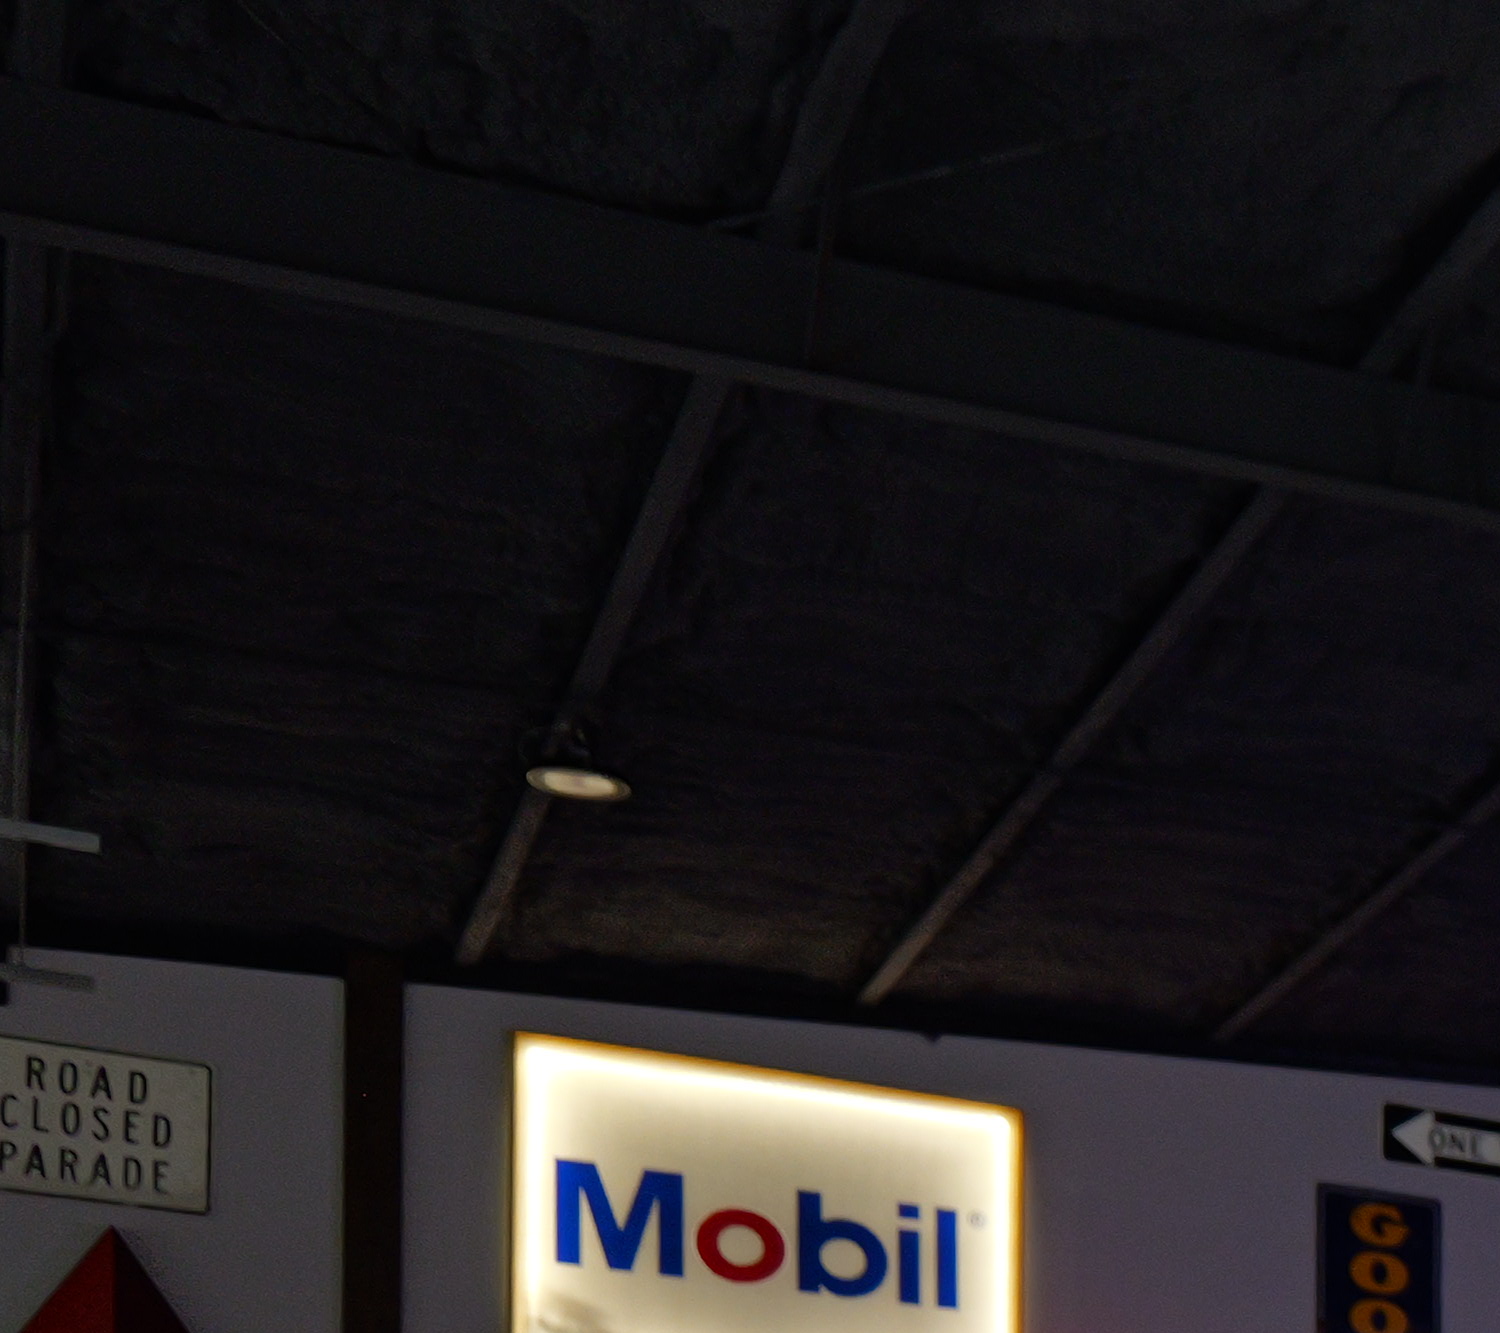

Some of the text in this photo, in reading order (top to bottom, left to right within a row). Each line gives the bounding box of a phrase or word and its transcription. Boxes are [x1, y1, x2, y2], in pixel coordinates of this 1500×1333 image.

[25, 1055, 149, 1105] ROAD
[0, 1093, 172, 1148] CLOSED
[1428, 1123, 1480, 1160] ONE
[0, 1141, 171, 1195] PARADE
[554, 1158, 959, 1310] Mobil
